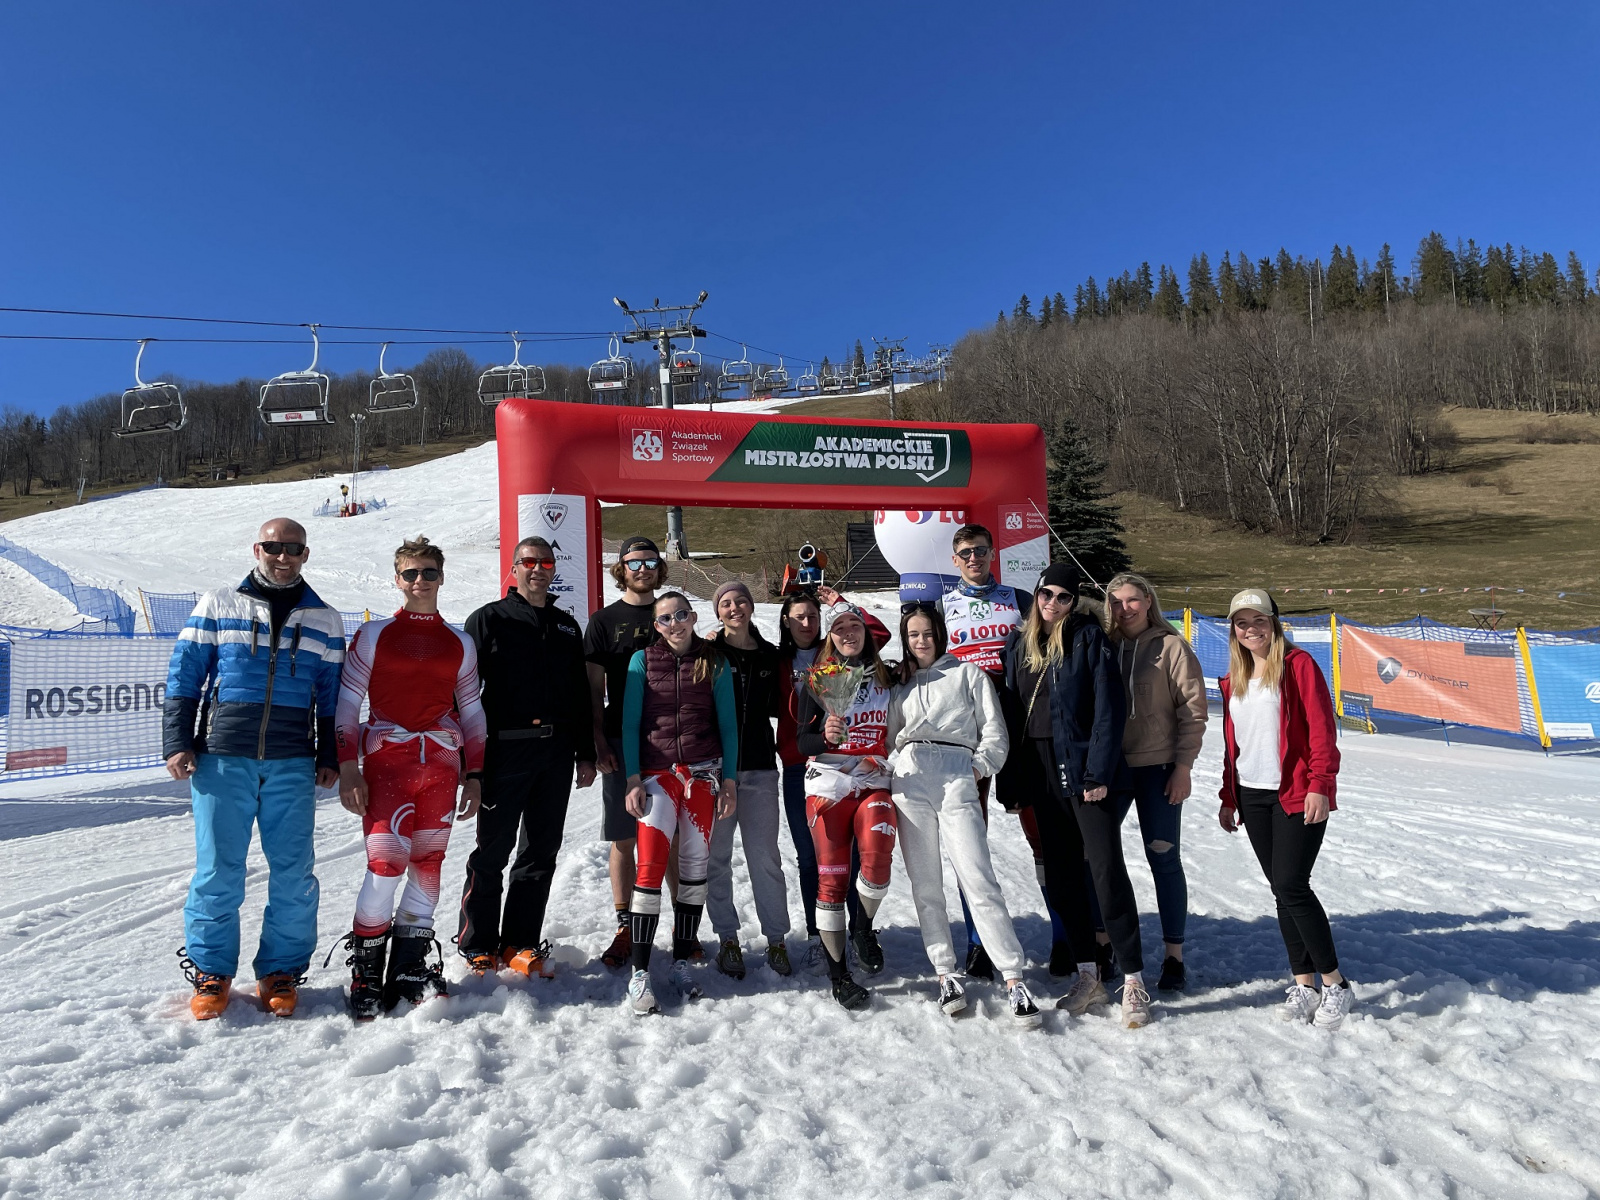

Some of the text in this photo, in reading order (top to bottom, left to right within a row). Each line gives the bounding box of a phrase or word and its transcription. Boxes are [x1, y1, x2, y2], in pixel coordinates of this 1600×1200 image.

[671, 431, 722, 441] Akademicki
[672, 441, 708, 452] Związek
[814, 436, 933, 454] AKADEMICKIE
[672, 452, 715, 464] Sportowy
[745, 449, 935, 471] MISTRZOSTWA POLSKI
[994, 602, 1016, 612] 214
[1406, 669, 1470, 690] DYNASTAR
[25, 682, 167, 720] ROSSIGNO
